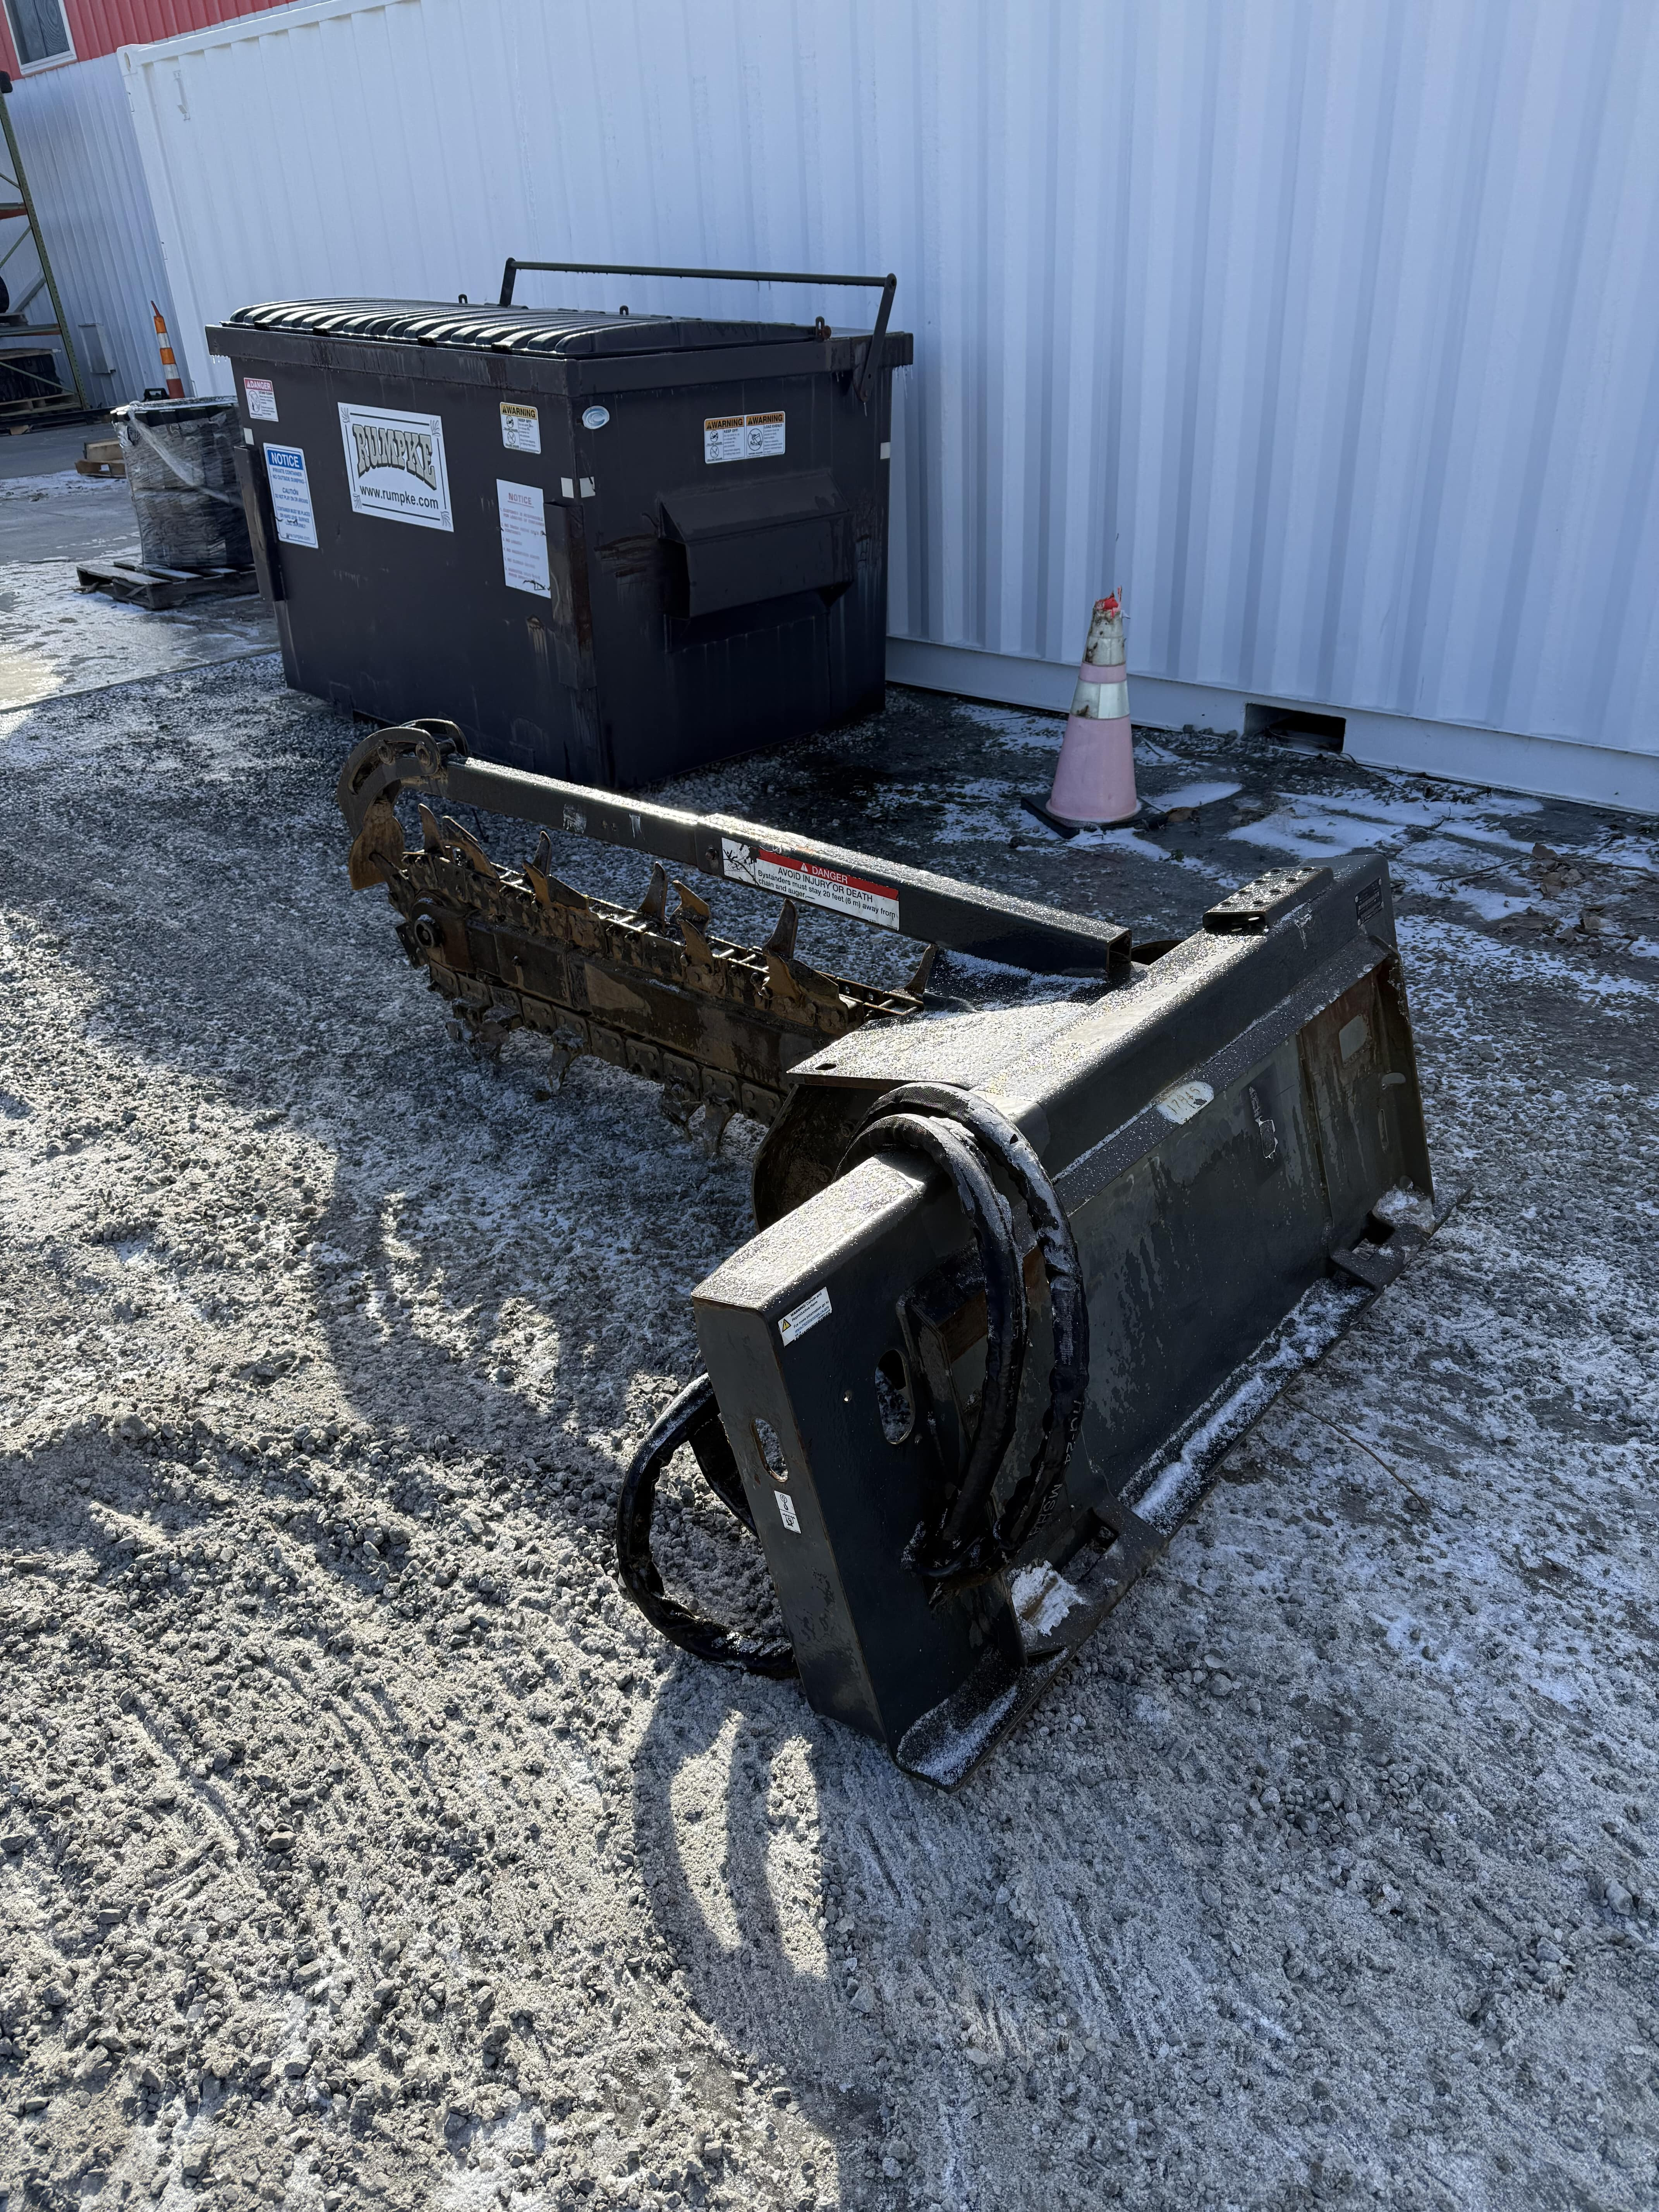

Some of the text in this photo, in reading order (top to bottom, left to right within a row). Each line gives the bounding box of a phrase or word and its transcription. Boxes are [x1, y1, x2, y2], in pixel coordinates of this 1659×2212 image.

[250, 381, 271, 390] DANGER
[507, 406, 536, 417] WARNING
[711, 418, 743, 428] WARNING
[752, 414, 782, 424] WARNING
[271, 452, 300, 468] NOTICE
[352, 424, 436, 491] RUMPKE
[282, 487, 299, 495] CAUTION
[360, 485, 438, 509] www.rumpke.com
[508, 493, 532, 505] NOTICE
[812, 866, 848, 884] DANGER
[759, 878, 807, 898] chain and auger.
[778, 867, 873, 903] AVOID INJURY OR DEATH
[758, 870, 790, 886] Bystanders
[792, 881, 807, 891] must
[809, 886, 821, 896] stay
[832, 893, 844, 902] feet
[853, 901, 861, 909] m)
[863, 903, 879, 914] away
[881, 908, 895, 918] from
[792, 1307, 810, 1321] Reproductive
[806, 1306, 822, 1319] information
